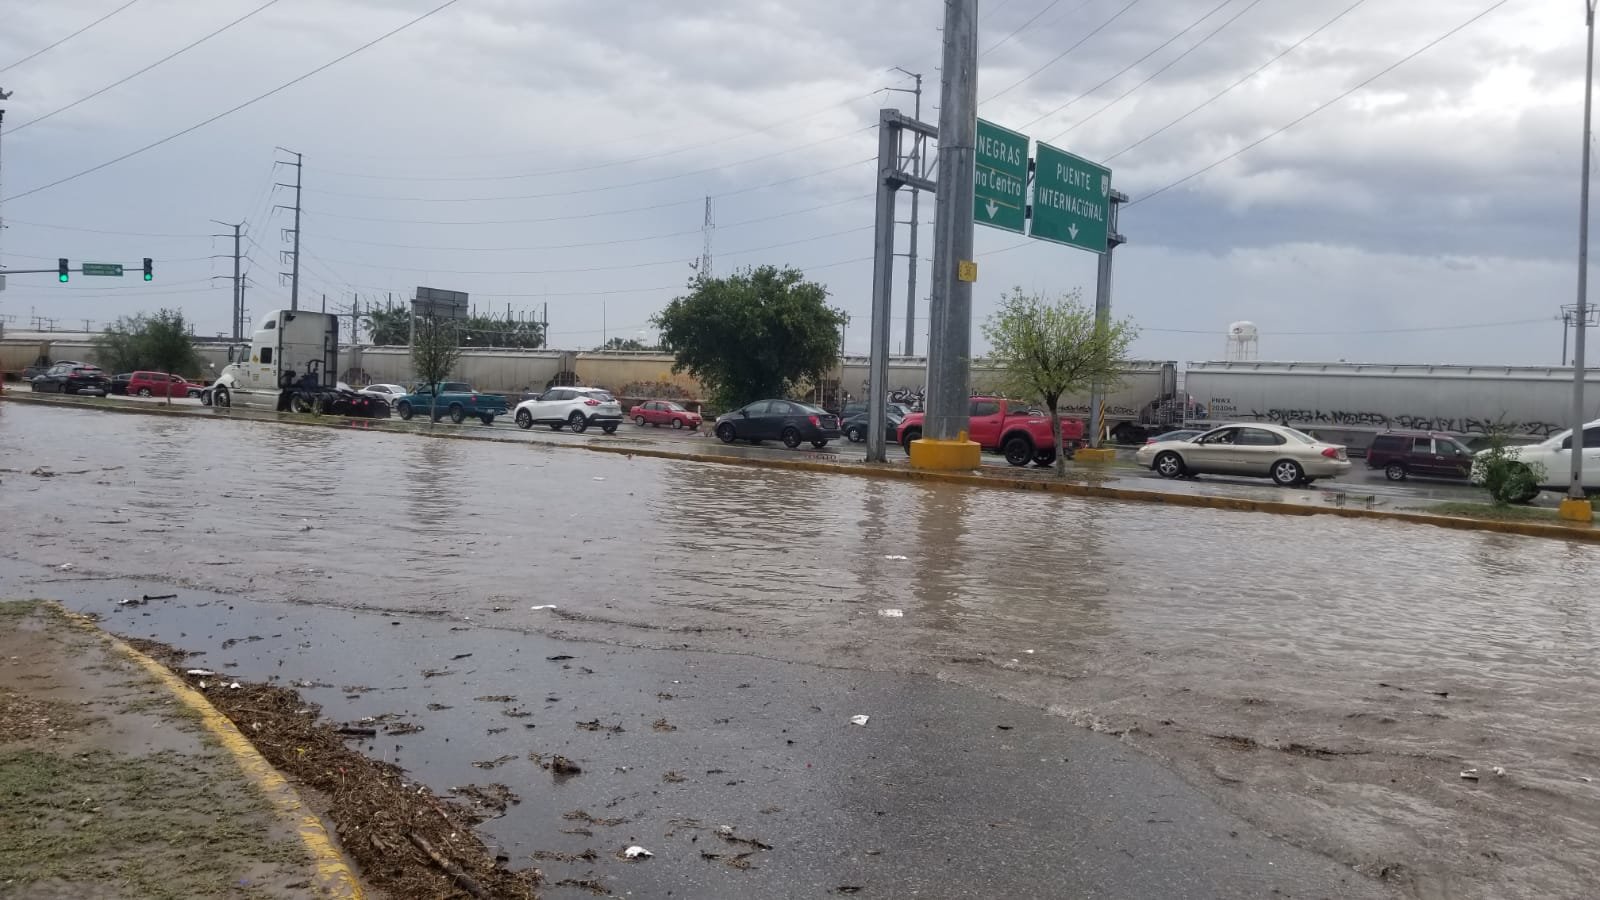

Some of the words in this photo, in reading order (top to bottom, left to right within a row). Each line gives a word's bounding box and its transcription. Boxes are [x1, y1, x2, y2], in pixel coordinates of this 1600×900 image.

[978, 135, 1020, 166] NEGRAS
[989, 169, 1021, 196] Centro
[1057, 163, 1091, 191] PUENTE
[1038, 186, 1103, 222] INTERNACIONAL
